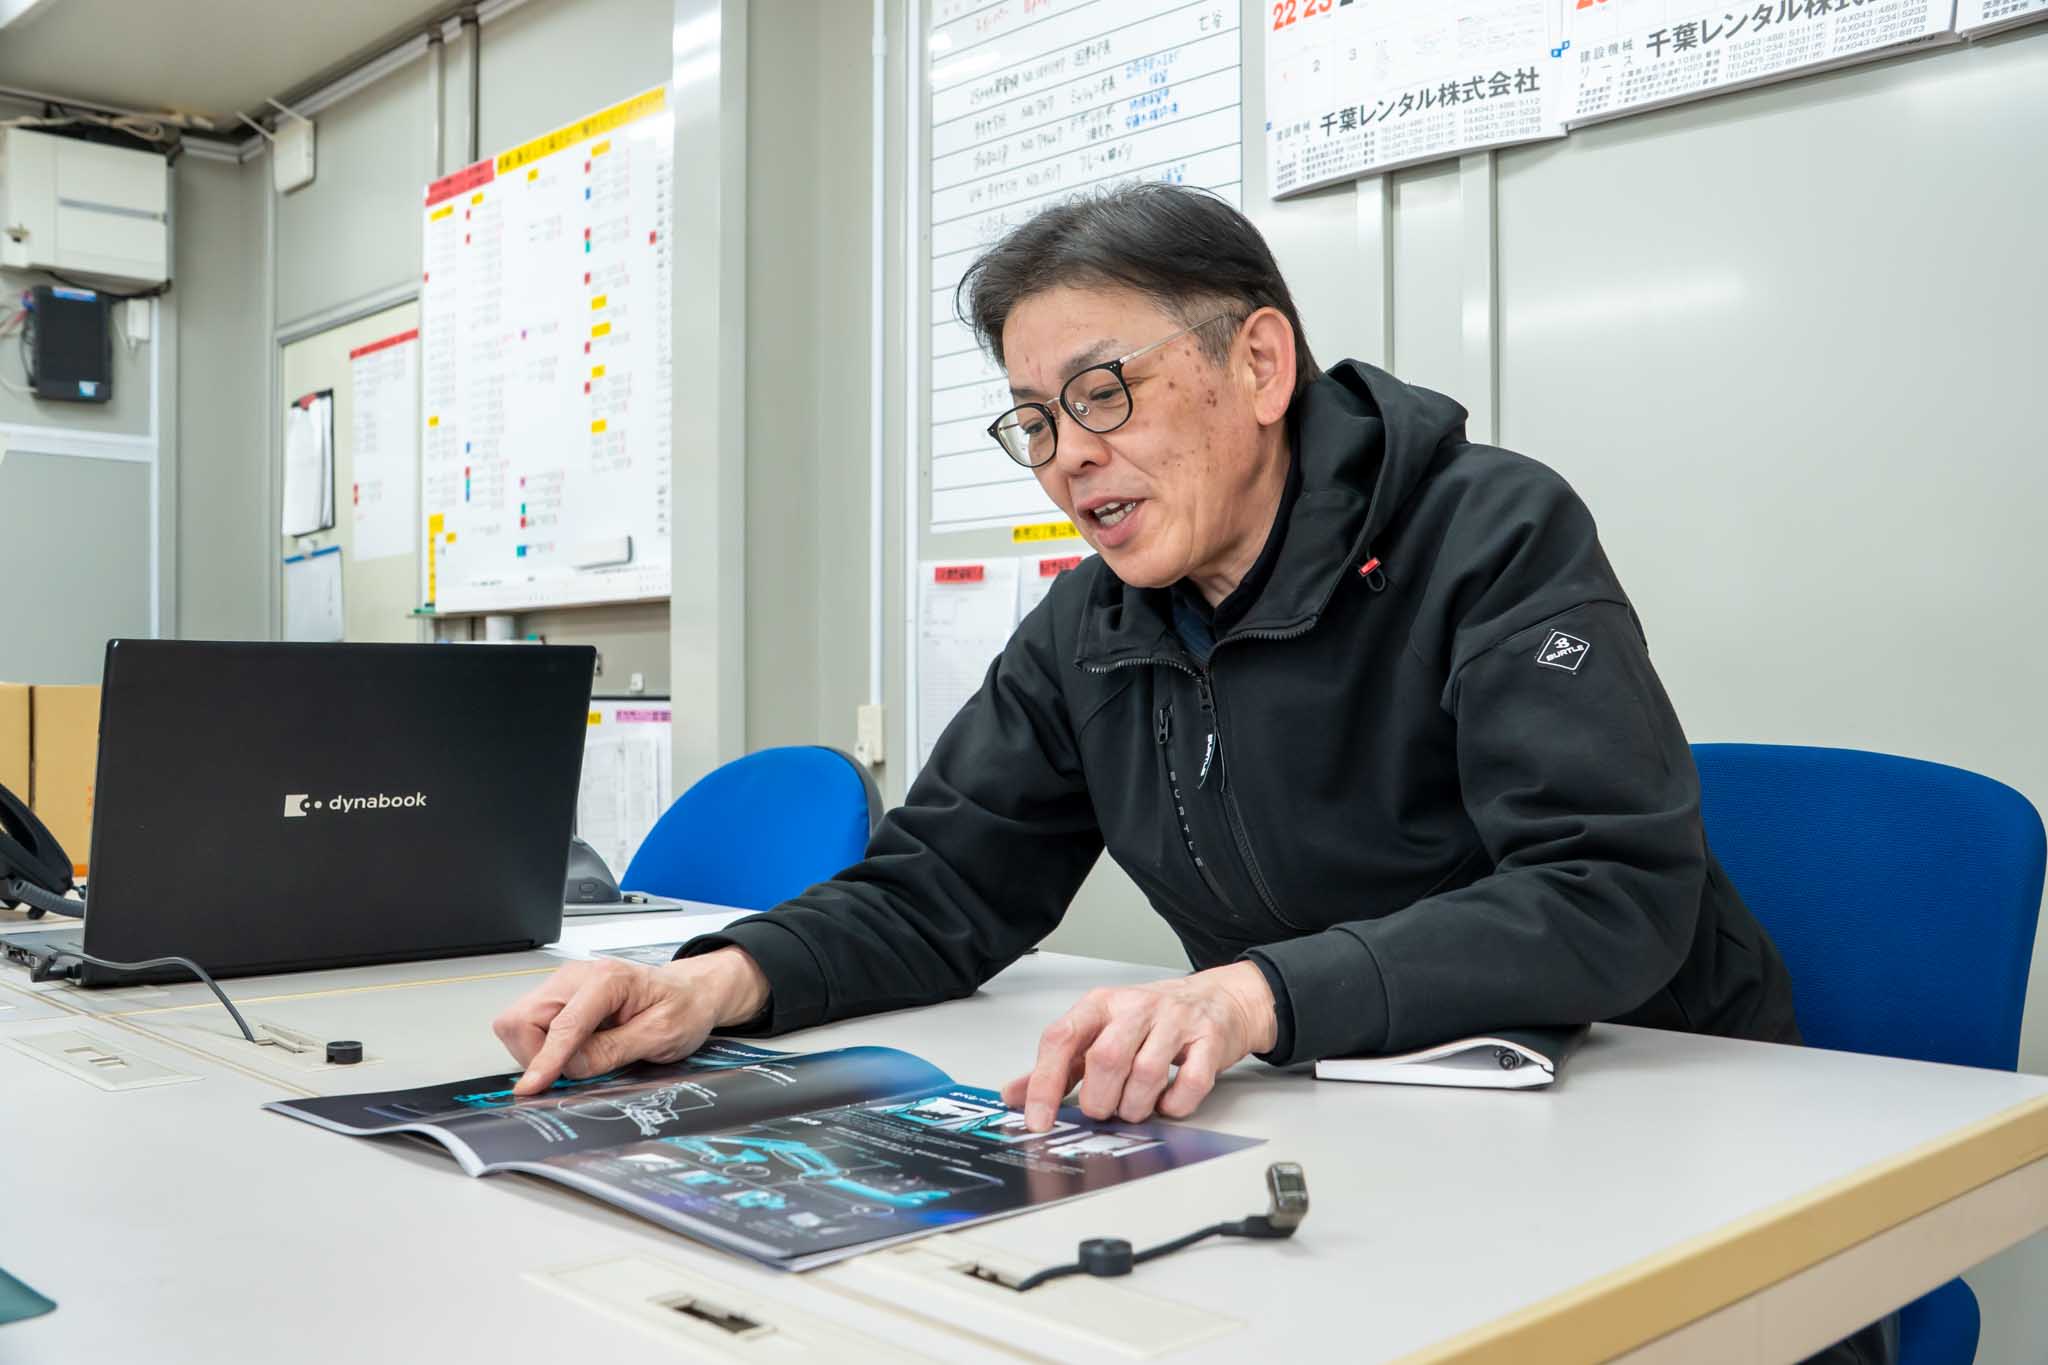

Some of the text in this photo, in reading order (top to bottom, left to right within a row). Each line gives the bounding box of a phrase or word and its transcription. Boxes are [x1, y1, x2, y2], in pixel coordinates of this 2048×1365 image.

[1273, 0, 1297, 31] 22
[1646, 0, 1882, 57] 千葉レンタル株
[1320, 66, 1540, 136] 千葉レンタル株式会社
[1546, 645, 1584, 662] BURTLE
[329, 792, 427, 813] dynabook
